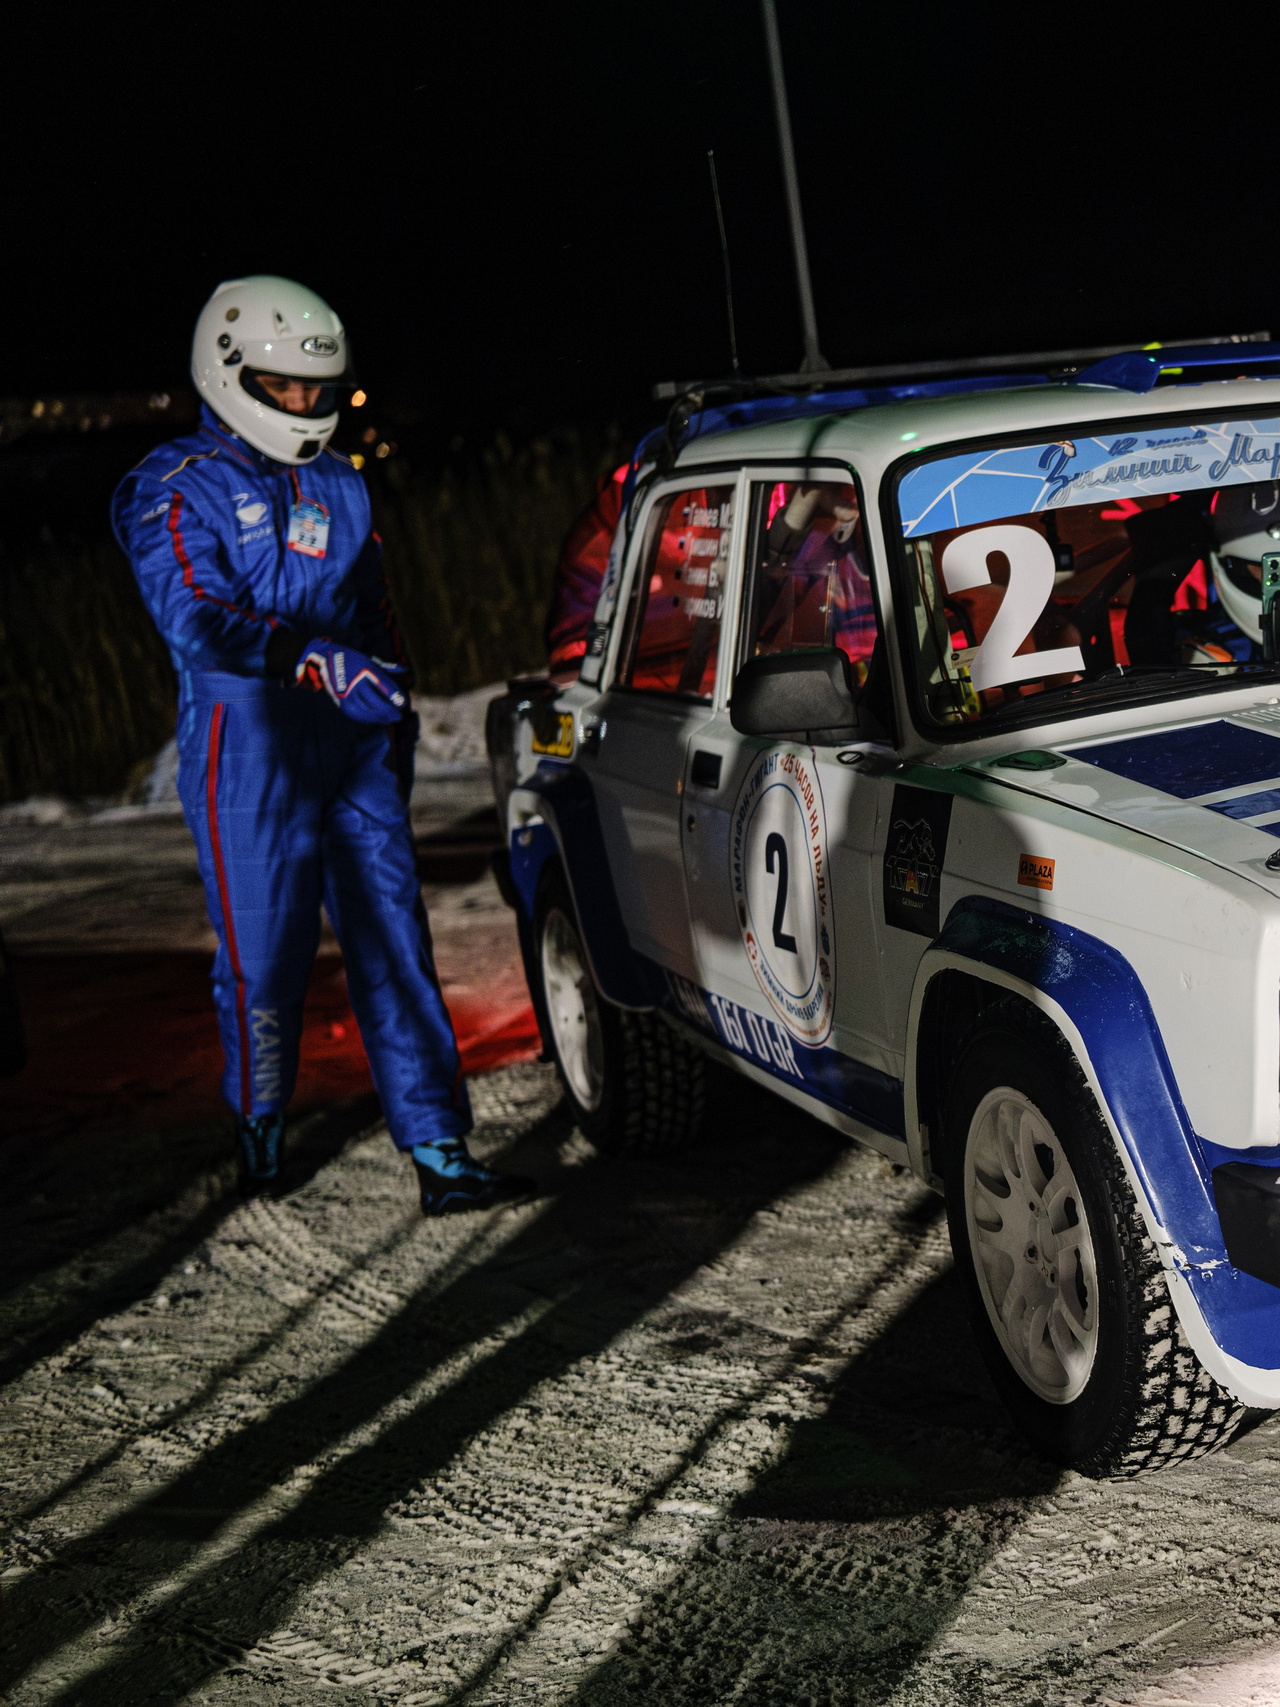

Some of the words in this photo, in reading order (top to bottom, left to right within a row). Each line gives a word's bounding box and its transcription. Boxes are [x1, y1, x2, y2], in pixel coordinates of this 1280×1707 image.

[1038, 441, 1201, 505] Зимний
[1108, 437, 1138, 456] 12
[941, 524, 1086, 692] 2
[795, 759, 814, 811] ЧАСОВ
[809, 808, 819, 840] НА
[765, 831, 798, 955] 2
[1028, 863, 1052, 879] PLAZA
